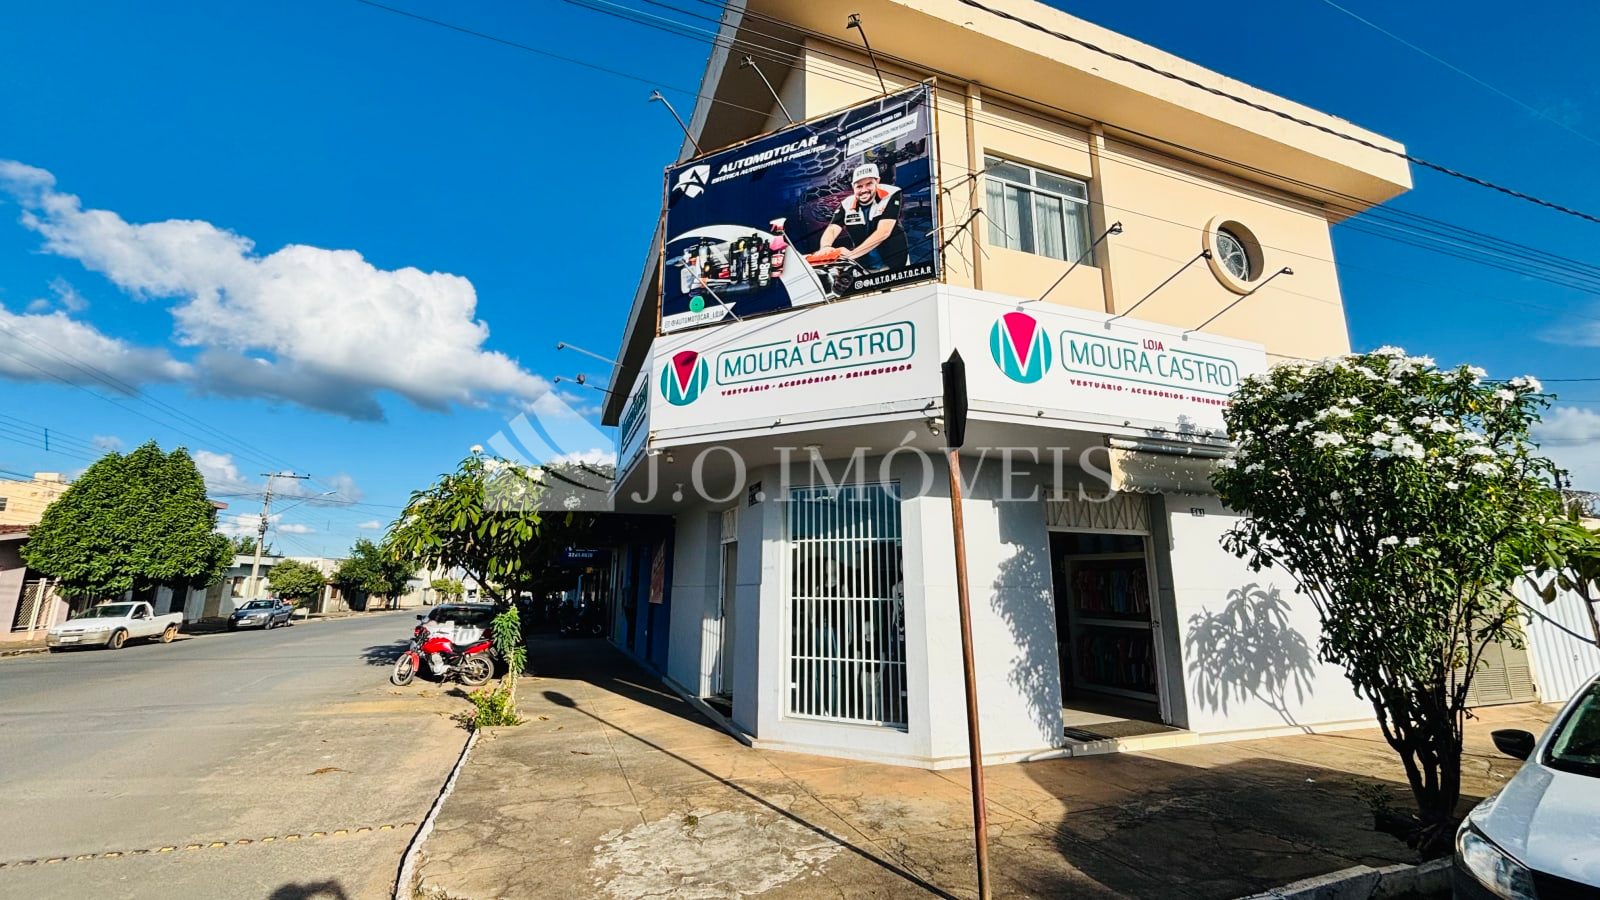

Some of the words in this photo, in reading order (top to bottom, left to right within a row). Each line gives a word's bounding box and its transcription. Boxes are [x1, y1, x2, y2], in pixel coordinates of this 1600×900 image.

[718, 135, 819, 174] AUTOMOTOCAR
[740, 158, 782, 176] AUTOMOTIVA
[788, 144, 827, 161] PRODUTOS
[724, 342, 804, 378] MOURA
[810, 328, 904, 364] CASTRO
[797, 330, 820, 343] LOJA
[1142, 338, 1165, 352] LOJA
[1069, 339, 1153, 375] MOURA
[1157, 354, 1232, 387] CASTRO
[720, 384, 770, 397] VESTUÁRIO
[778, 374, 837, 389] ACESSÓRIOS
[846, 363, 912, 379] BRINQUEDOS
[1070, 378, 1122, 392] VESTUÁRIO
[1131, 387, 1185, 401] ACESSÓRIOS
